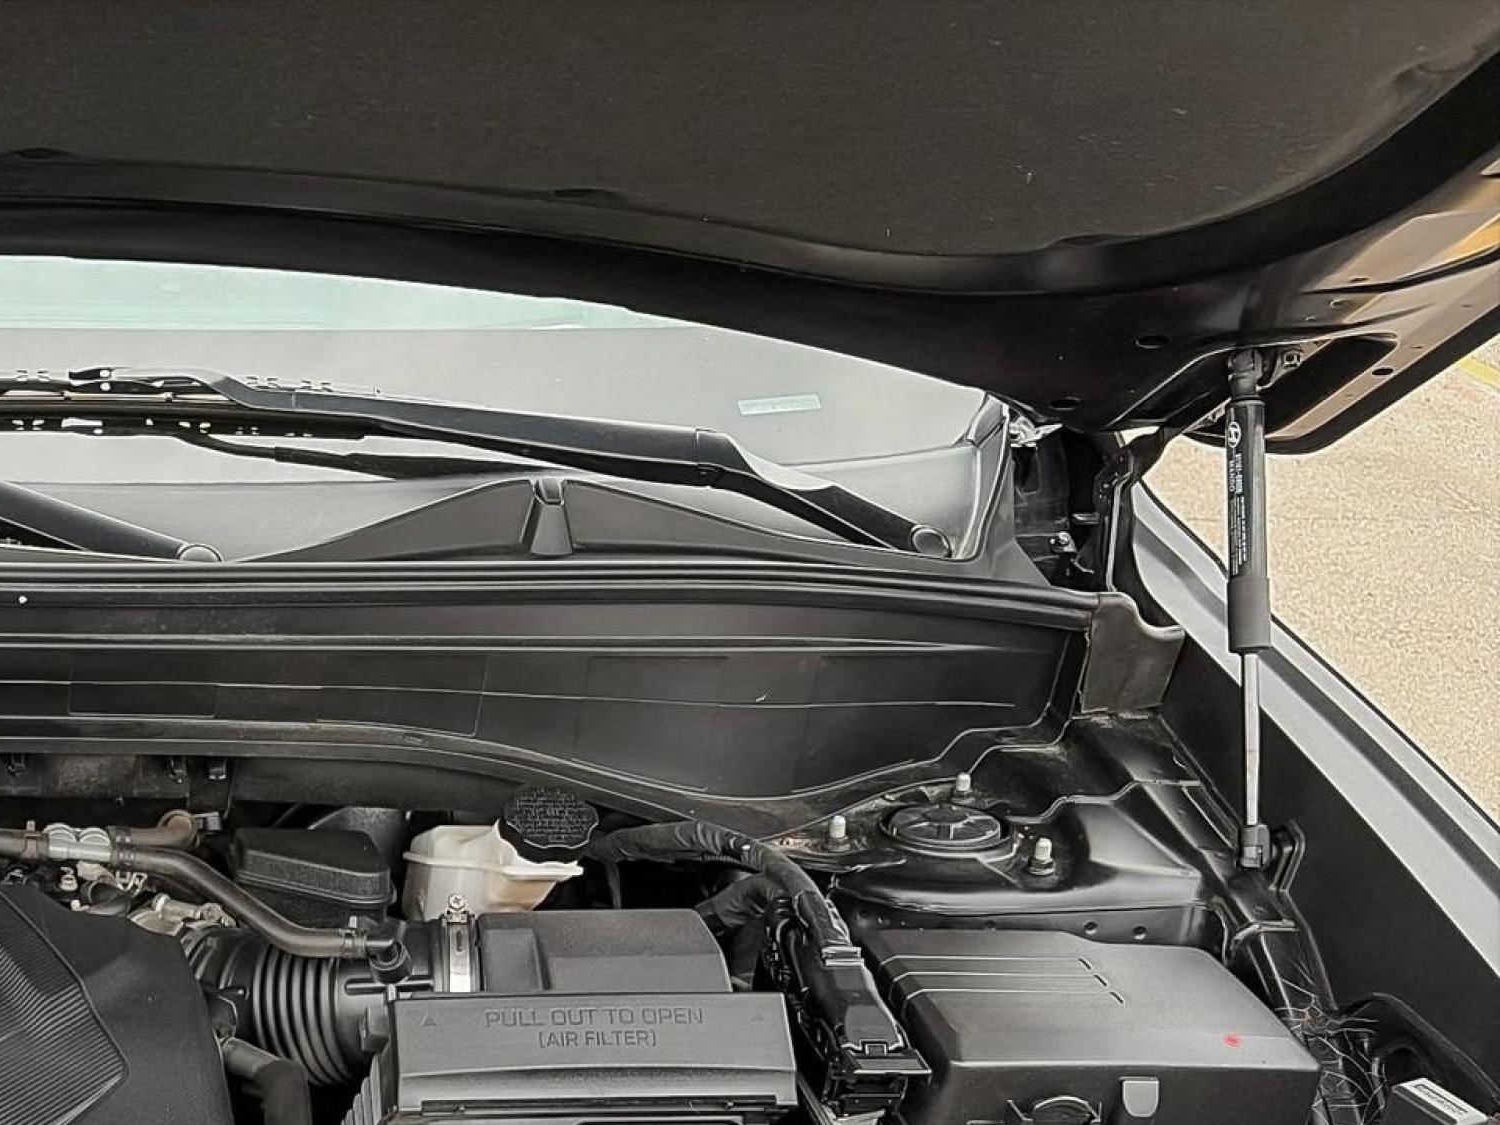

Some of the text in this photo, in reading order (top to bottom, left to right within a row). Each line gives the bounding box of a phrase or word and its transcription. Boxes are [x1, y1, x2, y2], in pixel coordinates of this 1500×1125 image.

[484, 1007, 704, 1027] PULL OUT TO OPEN
[538, 1030, 658, 1049] (AIR FILTER)
